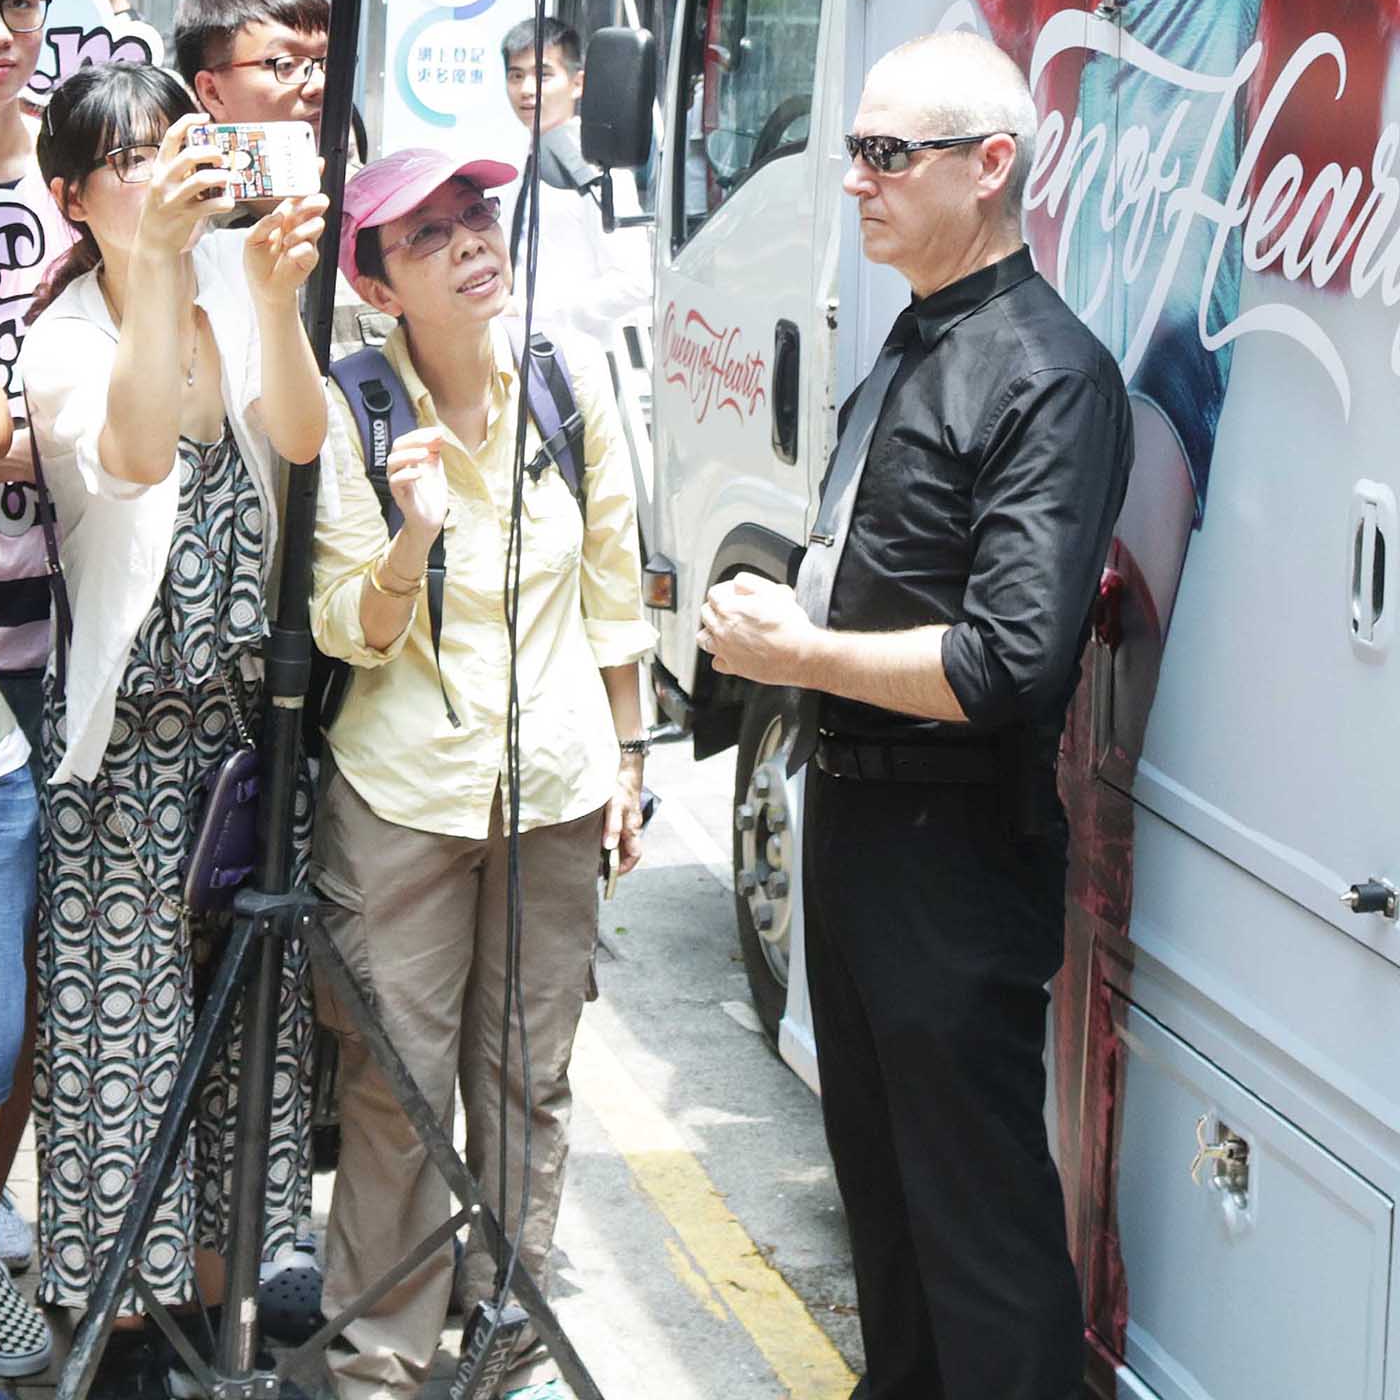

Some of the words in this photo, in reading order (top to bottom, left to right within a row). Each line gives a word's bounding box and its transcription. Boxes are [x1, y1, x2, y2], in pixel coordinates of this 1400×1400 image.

[662, 300, 701, 404] Queen
[685, 308, 766, 429] Hearts
[373, 418, 387, 467] NIKKO
